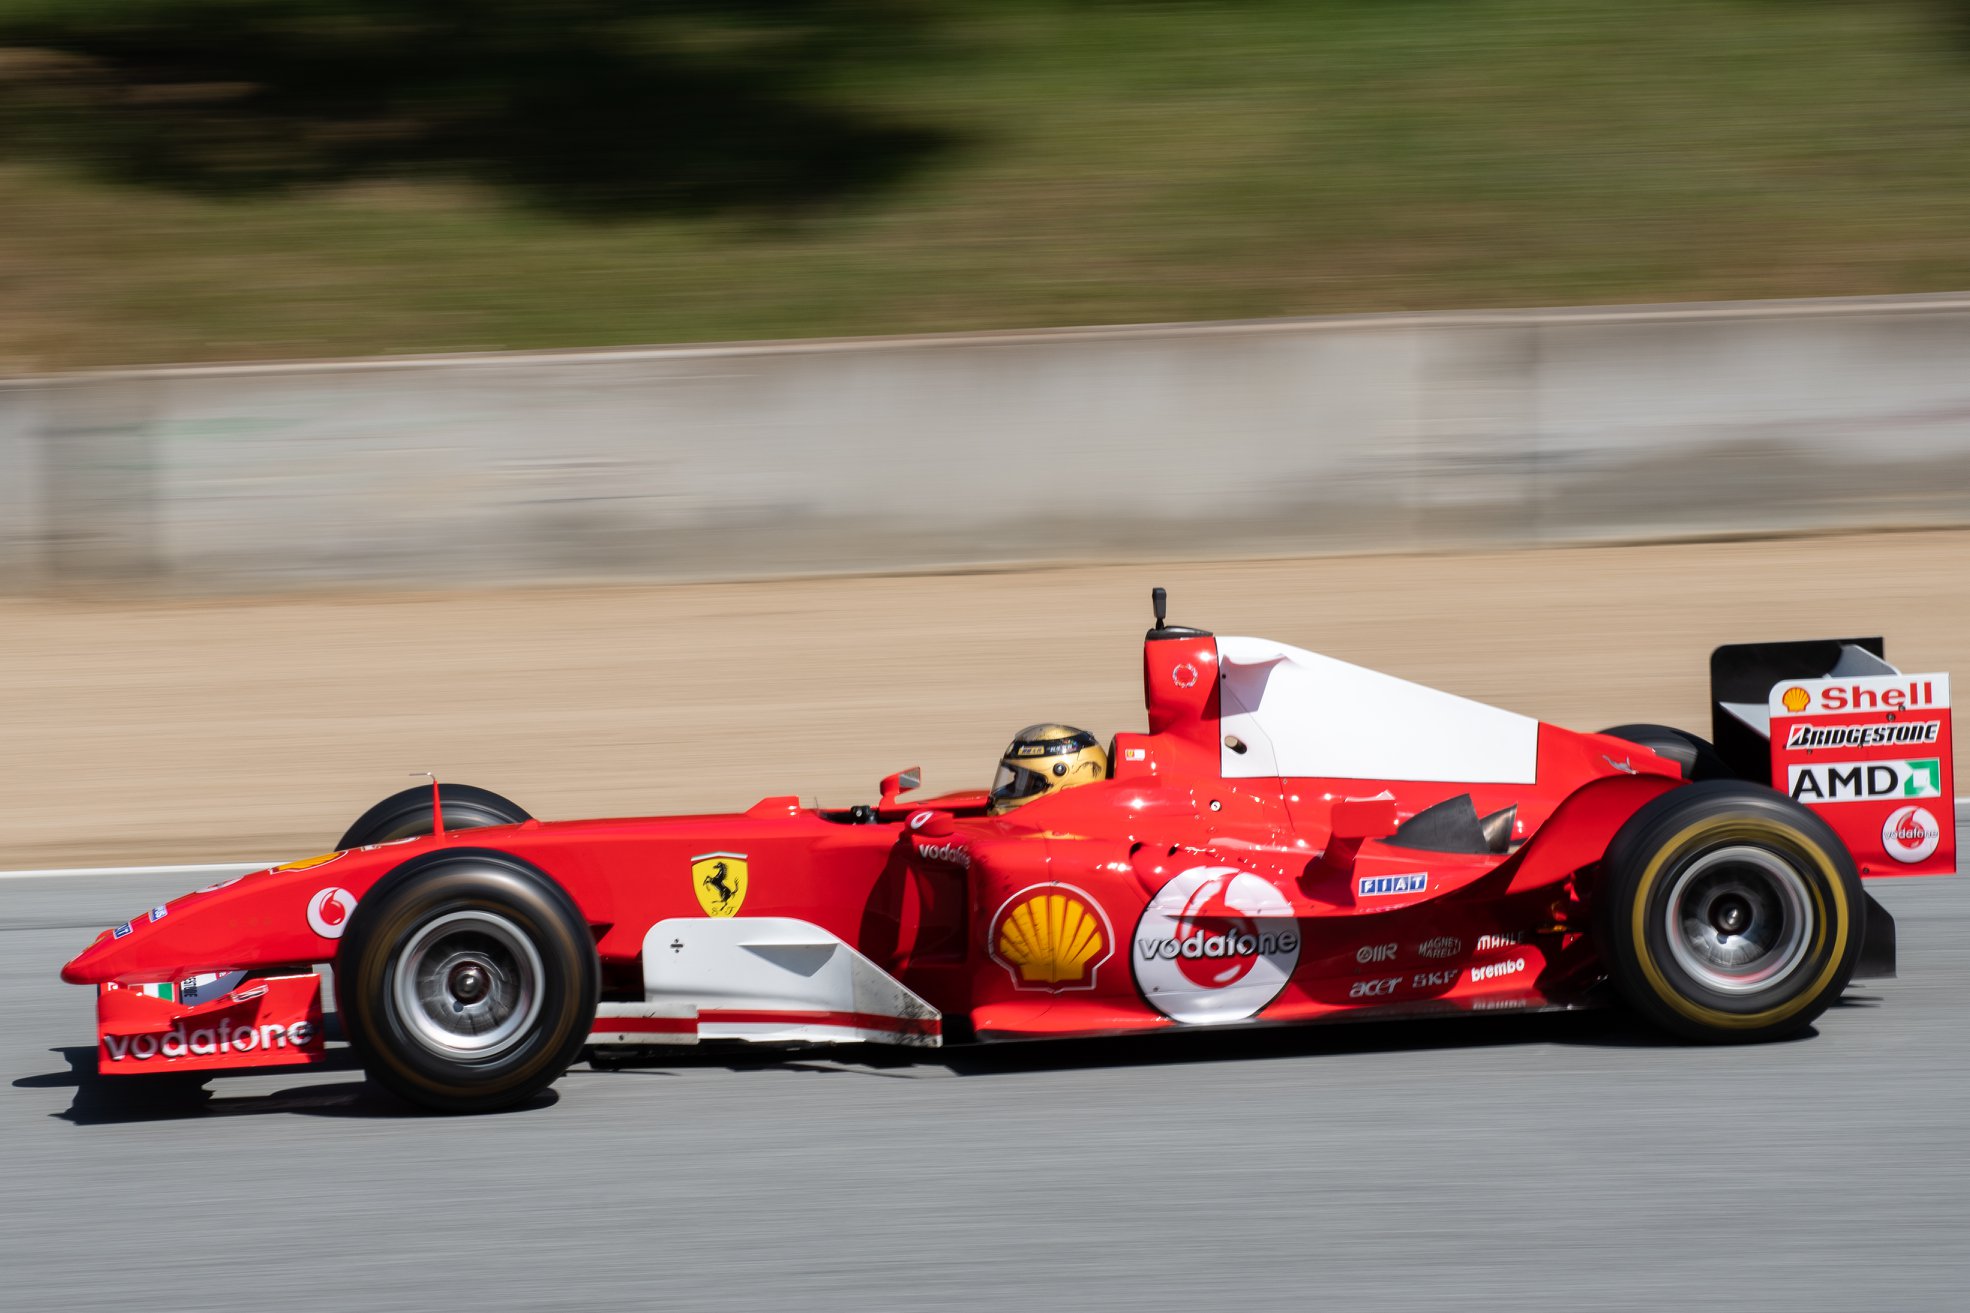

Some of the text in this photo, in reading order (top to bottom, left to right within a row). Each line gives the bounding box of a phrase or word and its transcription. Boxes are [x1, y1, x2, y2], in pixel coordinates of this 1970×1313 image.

[1821, 682, 1932, 709] Shell
[1789, 722, 1939, 748] BRIDGESTONE
[1791, 766, 1898, 800] AMD
[1884, 826, 1939, 839] vodafone
[1361, 874, 1426, 895] FIAT
[1138, 928, 1298, 960] vodafone
[1477, 931, 1525, 951] MAHLE
[1412, 969, 1459, 989] SKF
[1471, 958, 1525, 982] brembo
[1349, 976, 1403, 998] acer
[104, 1018, 313, 1061] vodafone
